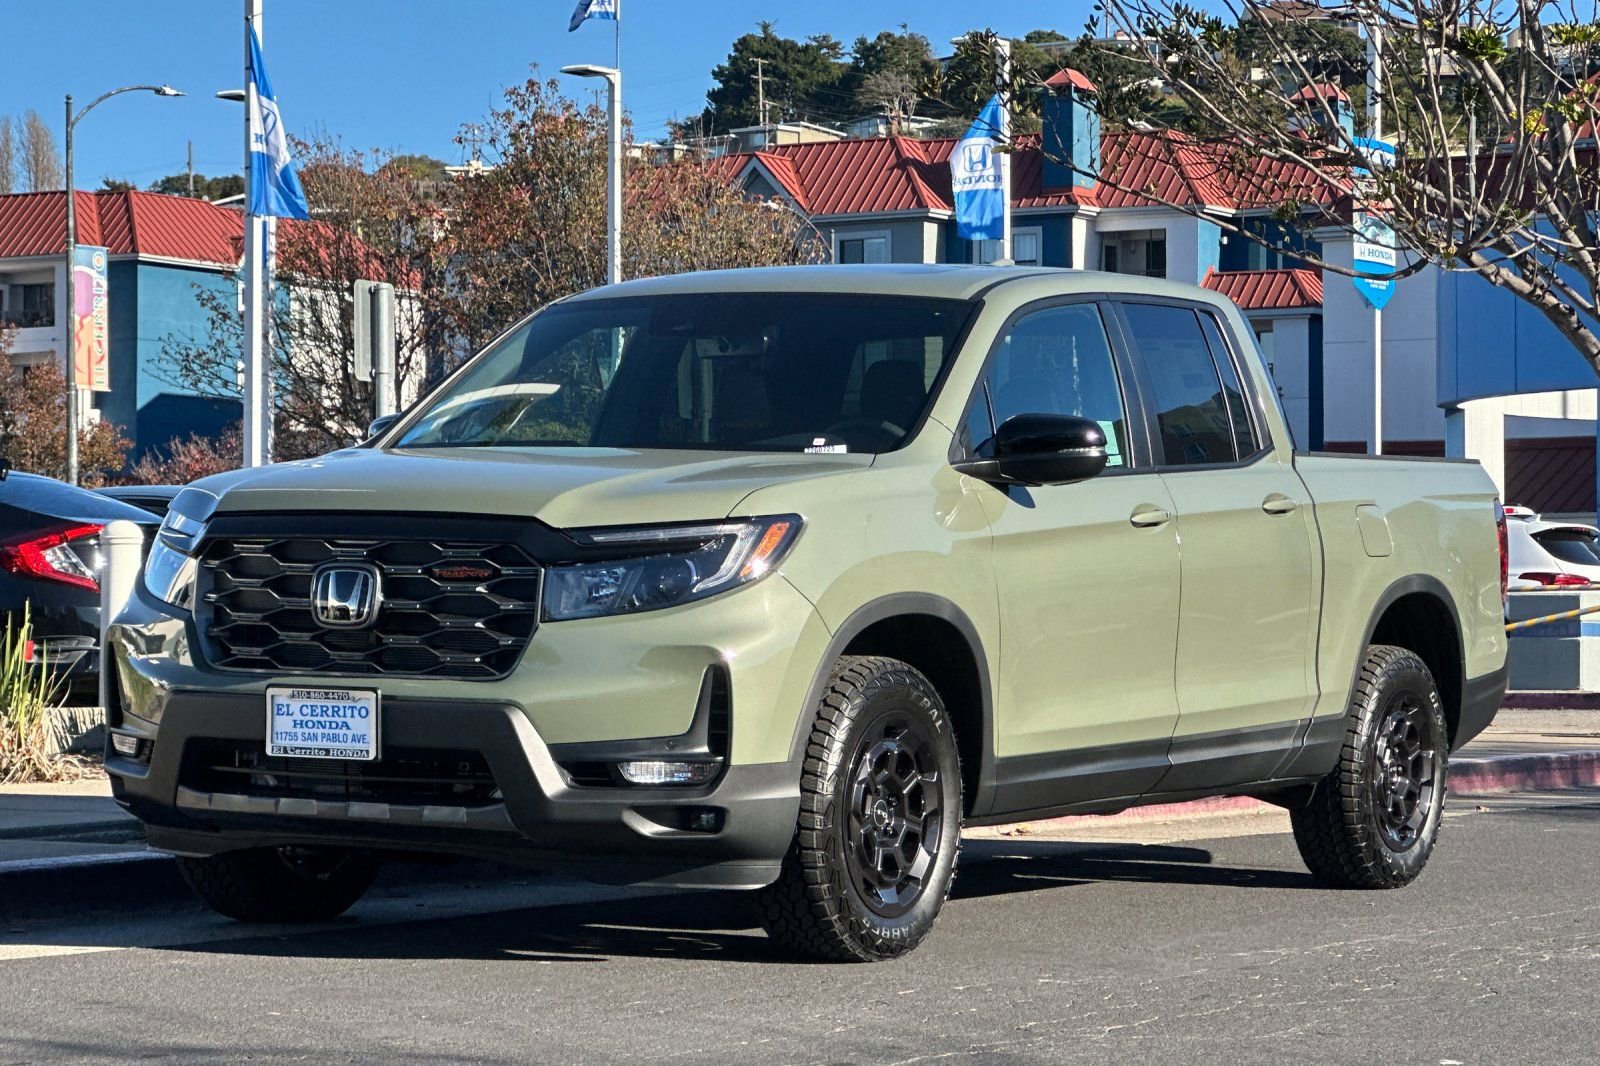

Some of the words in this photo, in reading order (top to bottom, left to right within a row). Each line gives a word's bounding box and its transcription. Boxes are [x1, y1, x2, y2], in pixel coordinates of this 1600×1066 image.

[1368, 248, 1393, 260] HONDA
[92, 251, 105, 355] CERRITO
[293, 691, 348, 700] 510-860-4470
[275, 703, 294, 717] EL
[299, 704, 369, 719] CERRITO
[292, 719, 352, 731] HONDA
[275, 731, 299, 742] 11755
[300, 732, 319, 743] SAN
[320, 733, 348, 744] PABLO
[351, 734, 370, 745] AVE.
[272, 746, 285, 755] El
[287, 746, 326, 756] Cerrito
[329, 748, 369, 758] HONDA
